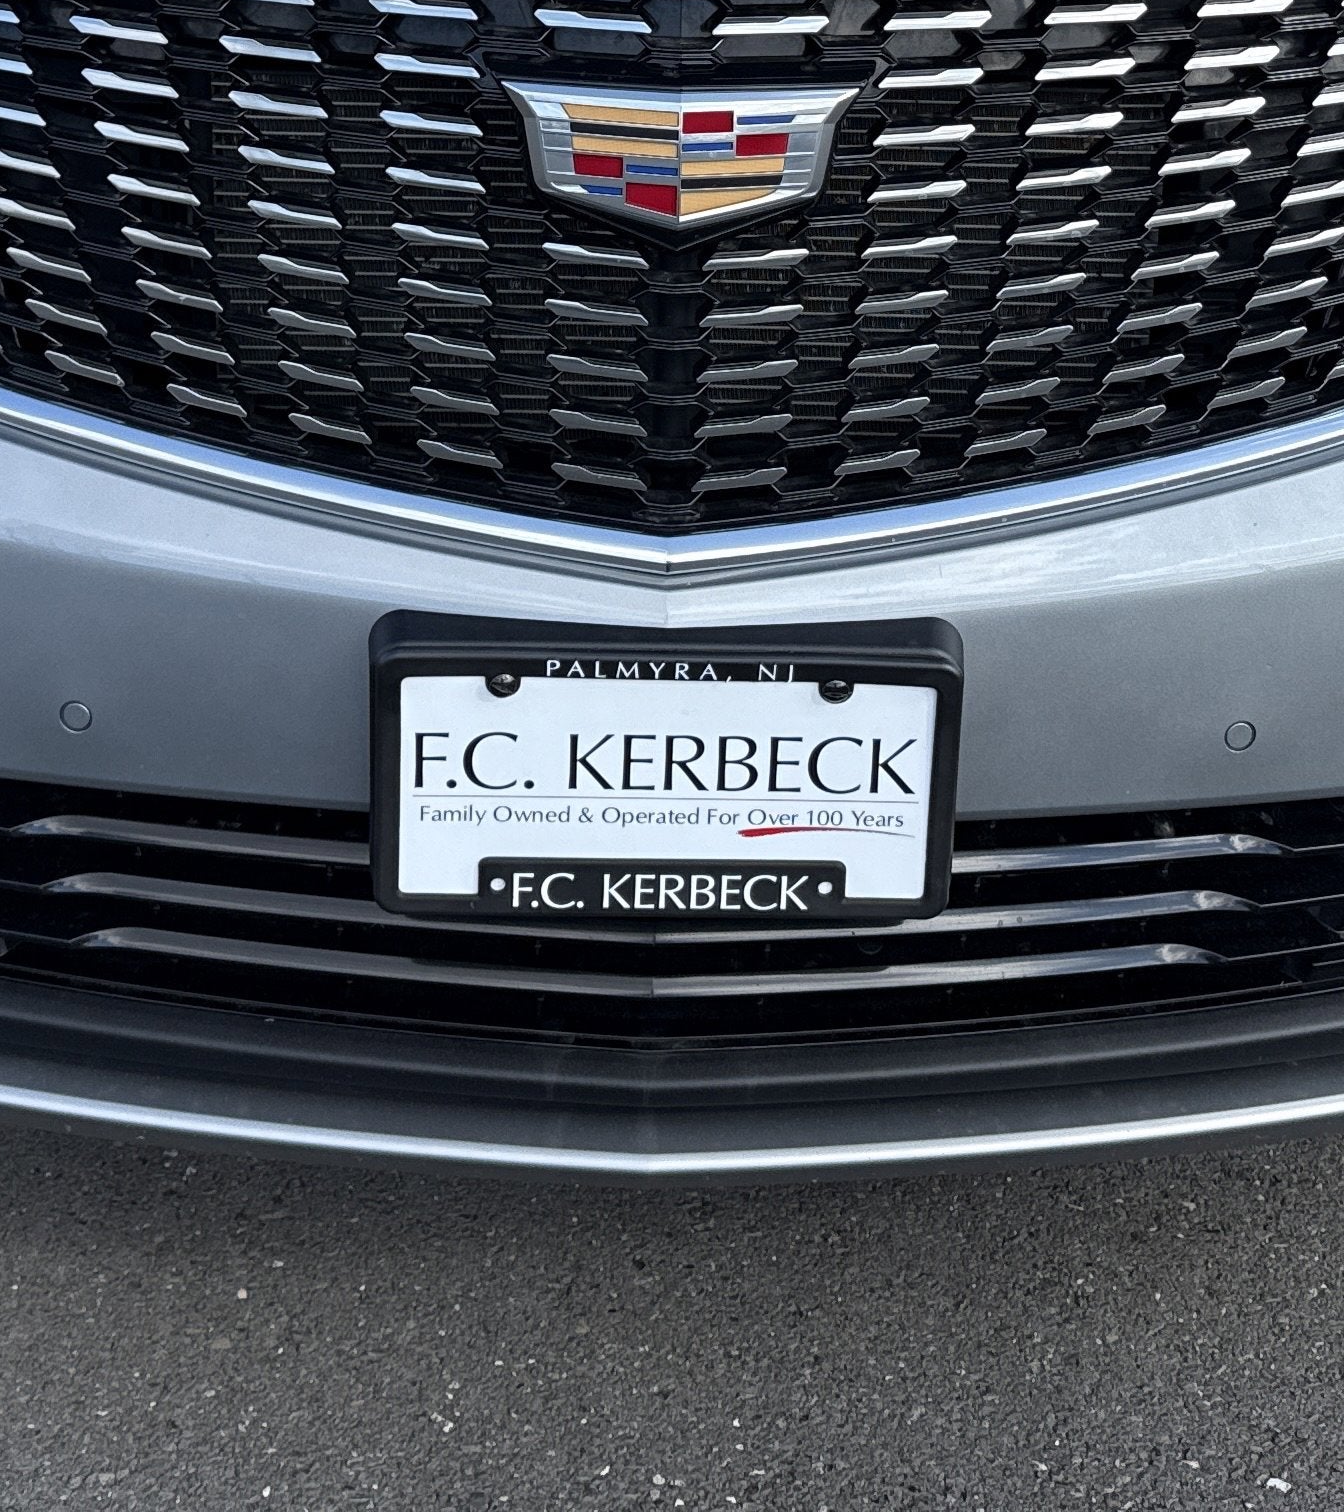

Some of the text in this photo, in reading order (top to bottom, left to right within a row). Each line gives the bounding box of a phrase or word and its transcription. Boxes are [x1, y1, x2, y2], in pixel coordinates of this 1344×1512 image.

[757, 663, 795, 684] NJ
[413, 731, 918, 796] F.C. KERBECK
[419, 804, 905, 830] Family Owned & Operated For Over 100 Years
[511, 872, 809, 911] F.C. KERBECK
